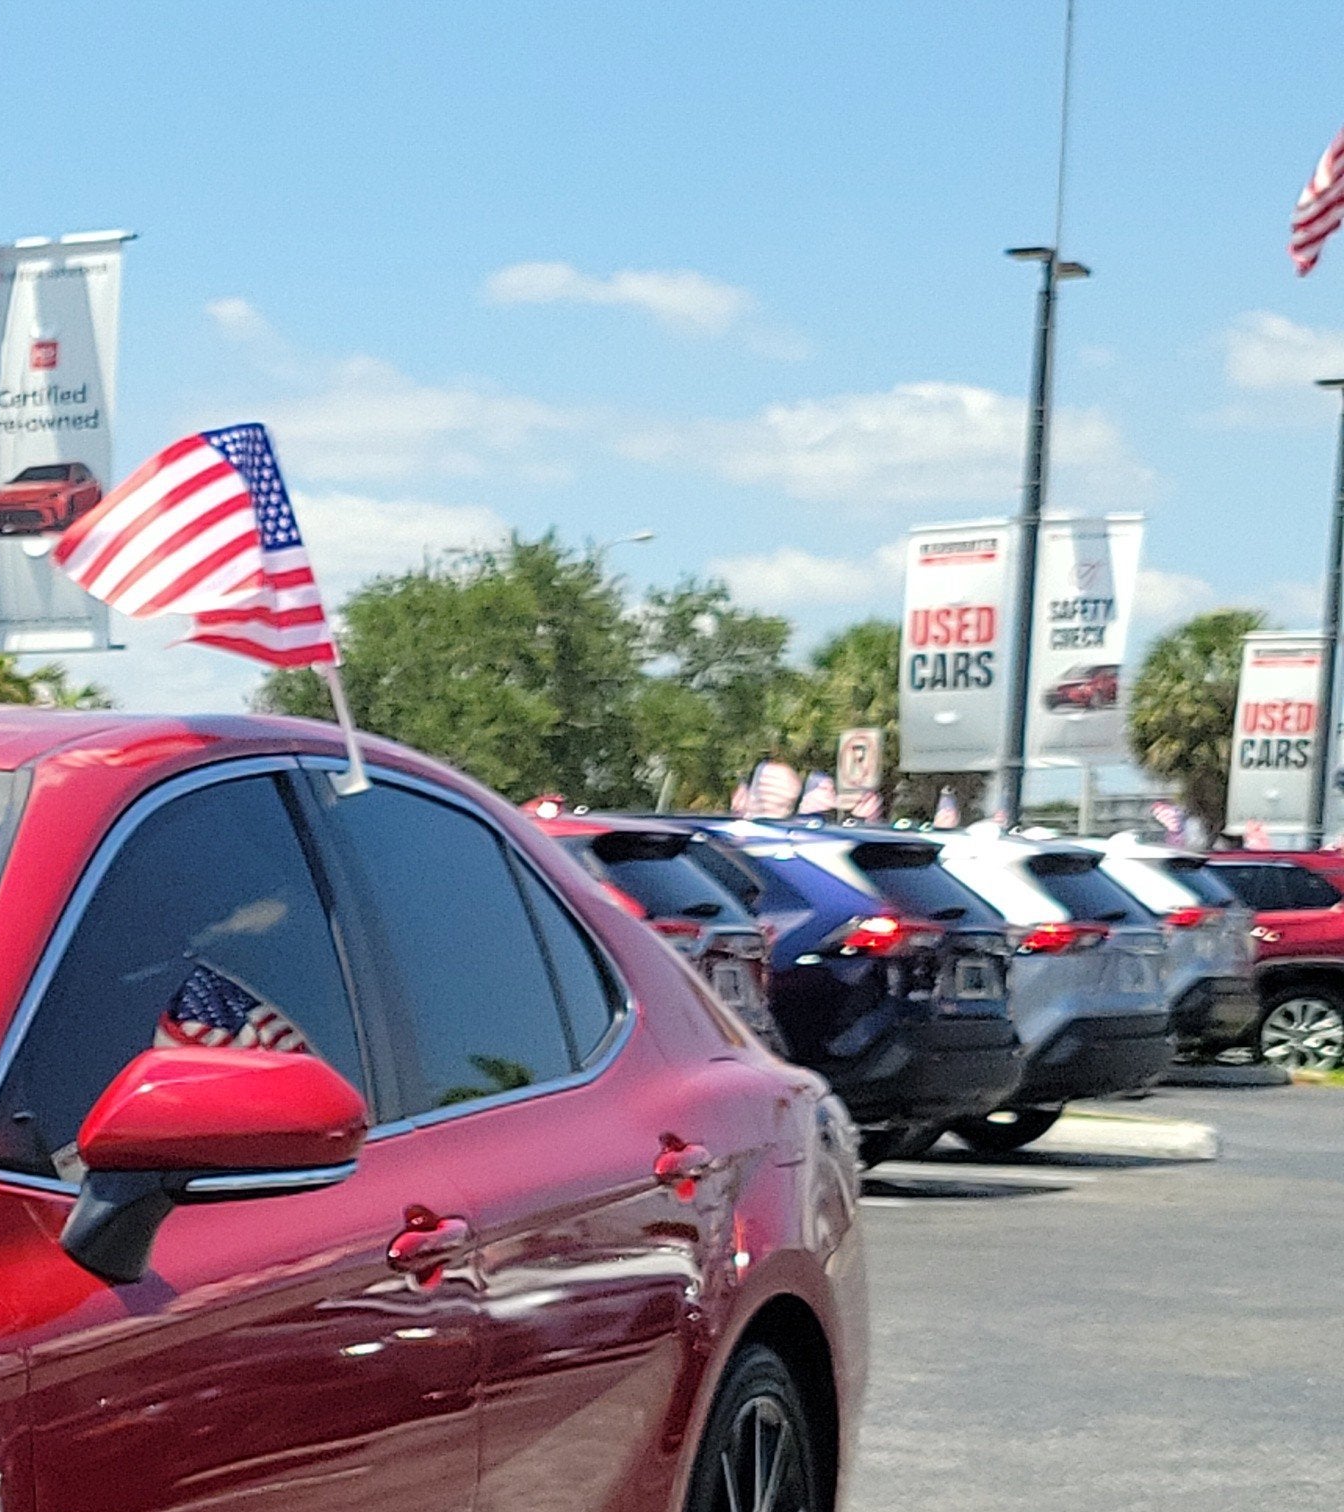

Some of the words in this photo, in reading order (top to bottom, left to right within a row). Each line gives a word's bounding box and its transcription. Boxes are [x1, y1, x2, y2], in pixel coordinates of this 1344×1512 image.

[1050, 598, 1114, 621] SAFETY
[911, 605, 996, 647] USED
[910, 650, 994, 691] CARS
[1243, 702, 1315, 734] USED
[1240, 738, 1311, 769] CARS
